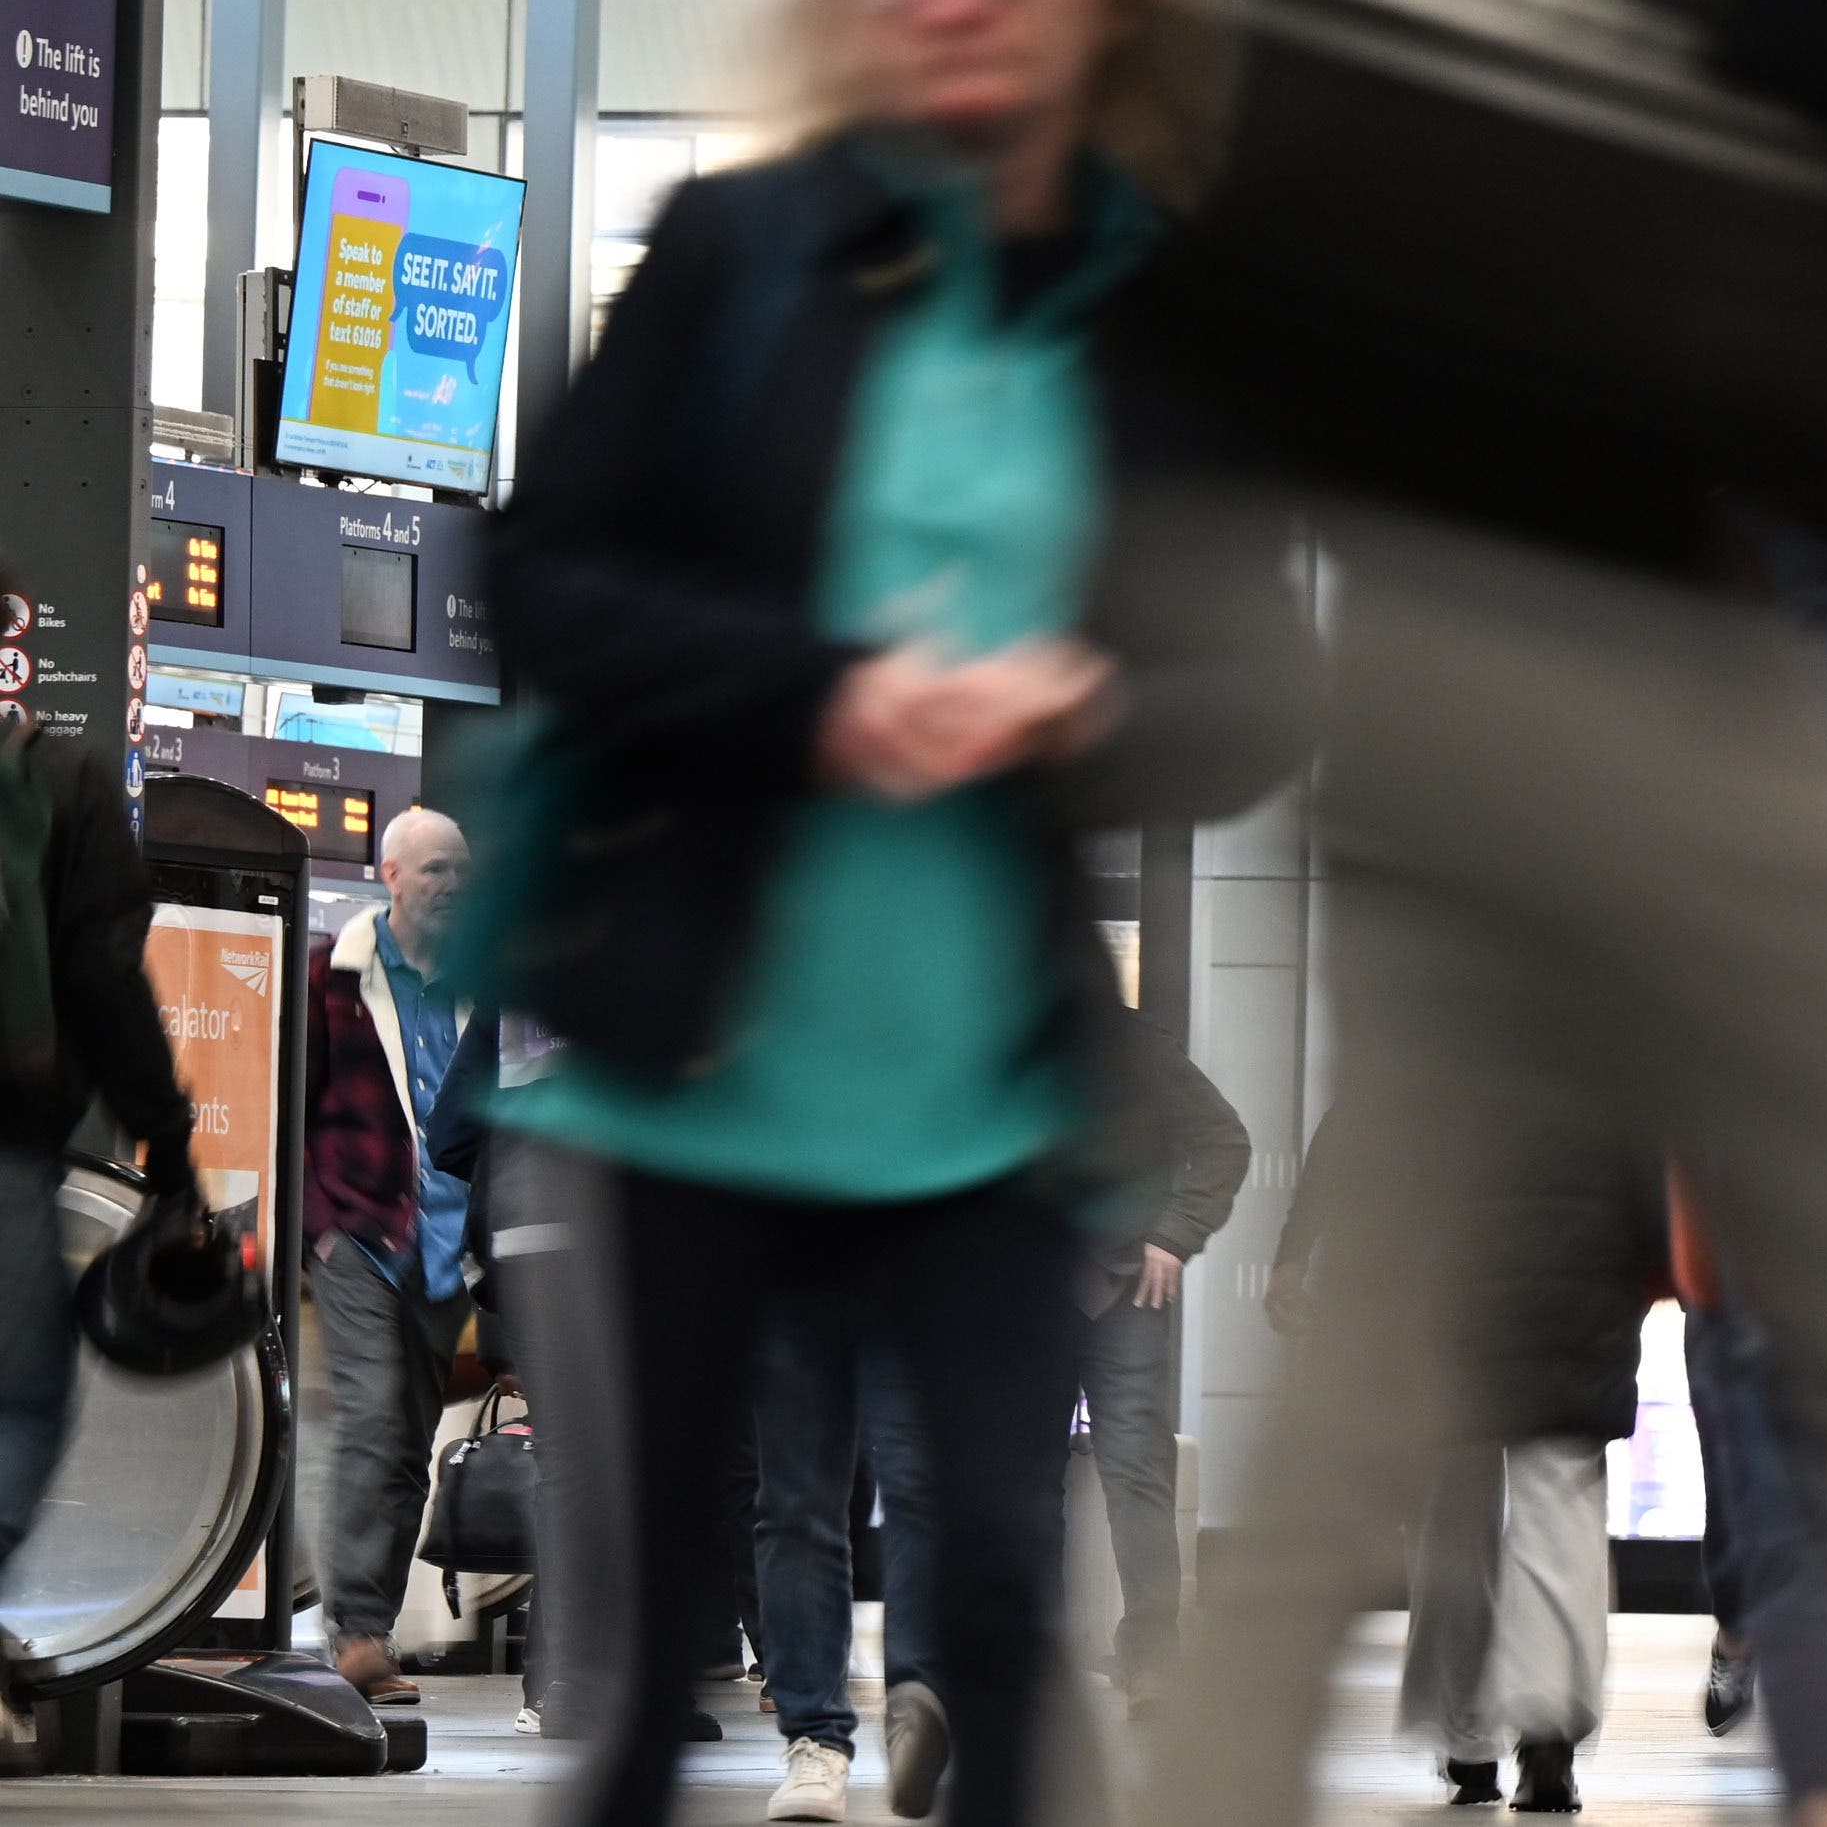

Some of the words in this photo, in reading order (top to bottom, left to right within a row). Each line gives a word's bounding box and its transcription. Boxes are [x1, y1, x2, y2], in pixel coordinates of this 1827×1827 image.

[36, 37, 62, 70] The
[64, 42, 85, 75] lift
[88, 48, 100, 78] is
[20, 84, 69, 122] behind
[71, 102, 98, 131] you
[339, 237, 370, 265] Speak
[370, 245, 383, 266] to
[335, 271, 342, 286] a
[343, 271, 386, 293] member
[401, 252, 432, 288] SEE
[431, 259, 448, 292] IT.
[451, 262, 482, 297] SAY
[481, 268, 499, 301] IT.
[333, 294, 345, 315] of
[344, 295, 372, 320] staff
[370, 305, 383, 321] or
[330, 321, 352, 344] text
[352, 325, 382, 349] 61016
[414, 303, 478, 345] SORTED.
[165, 480, 176, 511] 4
[339, 516, 381, 540] Platforms
[382, 512, 393, 541] 4
[393, 526, 410, 544] and
[411, 515, 421, 546] 5
[38, 603, 55, 614] No
[458, 598, 473, 619] The
[38, 617, 66, 628] Bikes
[449, 627, 478, 650] behind
[38, 658, 55, 669] No
[37, 671, 97, 684] pushchairs
[36, 710, 53, 721] No
[54, 711, 88, 724] heavy
[332, 756, 340, 781] 3
